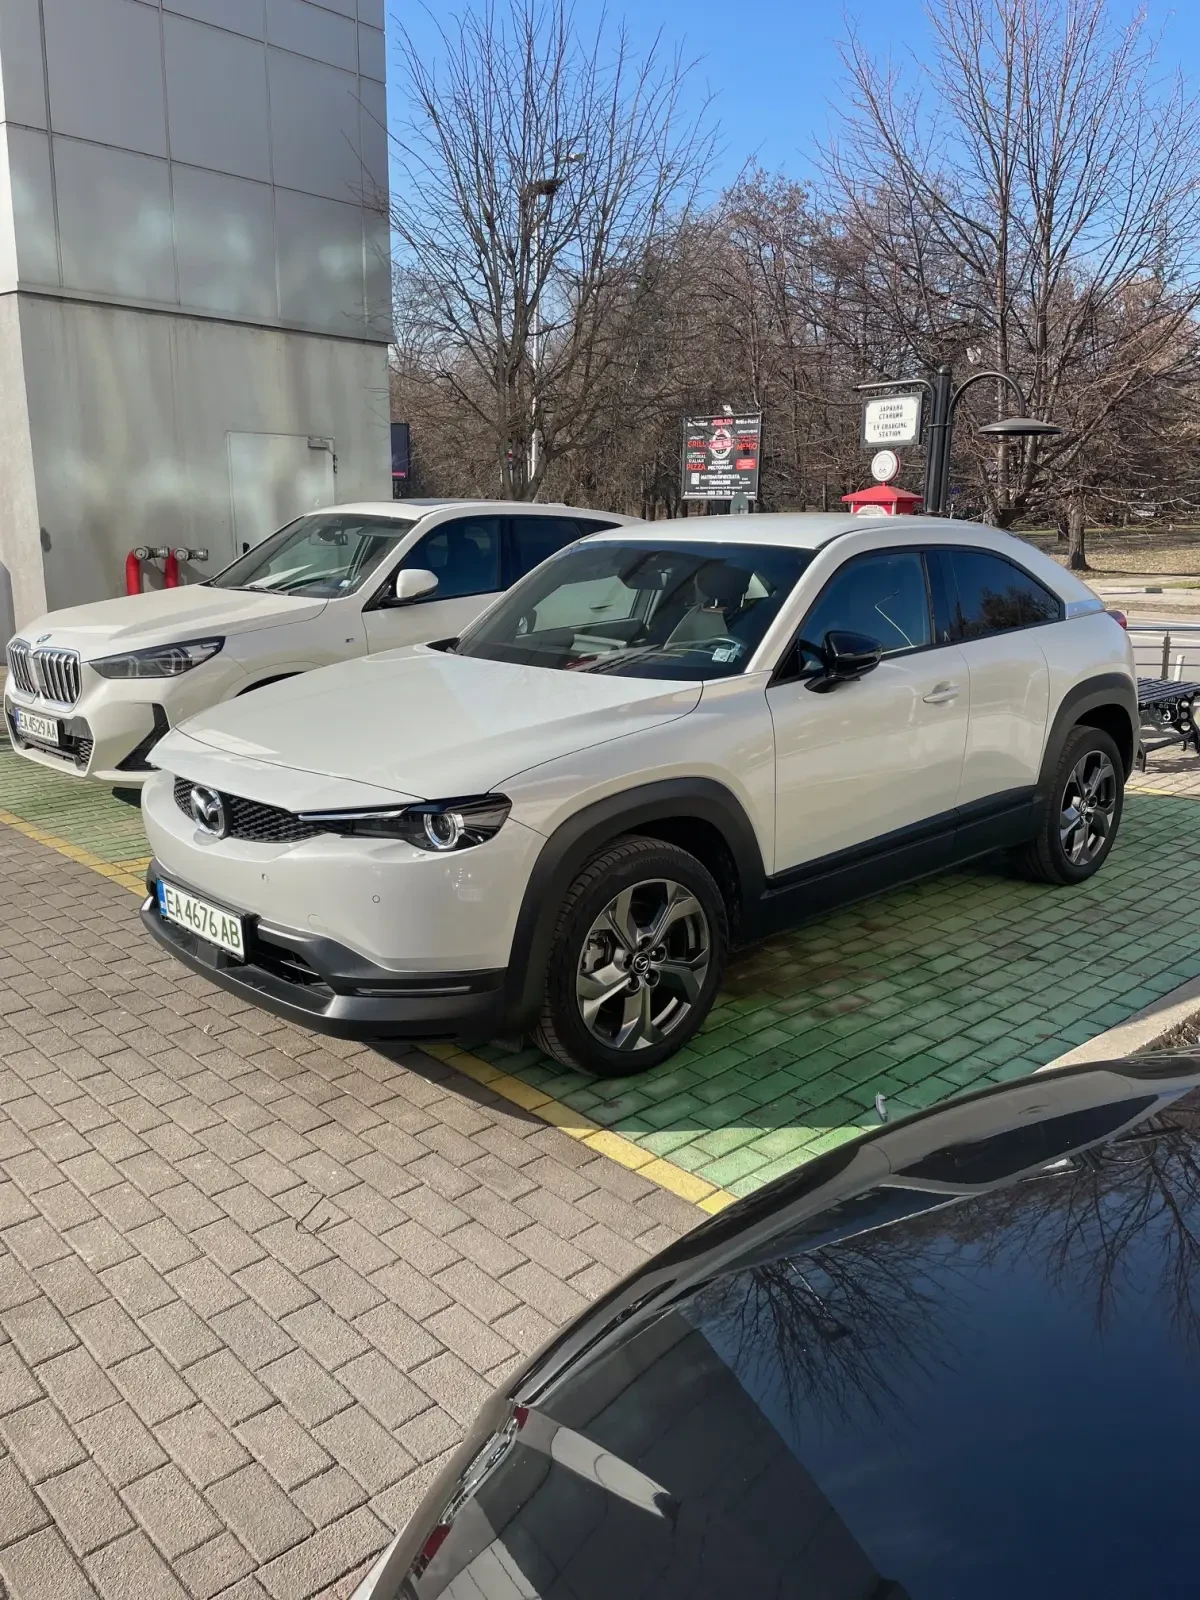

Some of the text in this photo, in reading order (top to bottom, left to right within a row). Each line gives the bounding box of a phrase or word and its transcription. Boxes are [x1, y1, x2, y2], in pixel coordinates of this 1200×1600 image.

[881, 422, 907, 430] CHARGING
[687, 440, 706, 448] GRILL
[29, 716, 45, 735] 4529
[47, 721, 57, 739] AA
[165, 888, 184, 921] EA
[185, 899, 218, 938] 4676
[221, 915, 241, 949] AB
